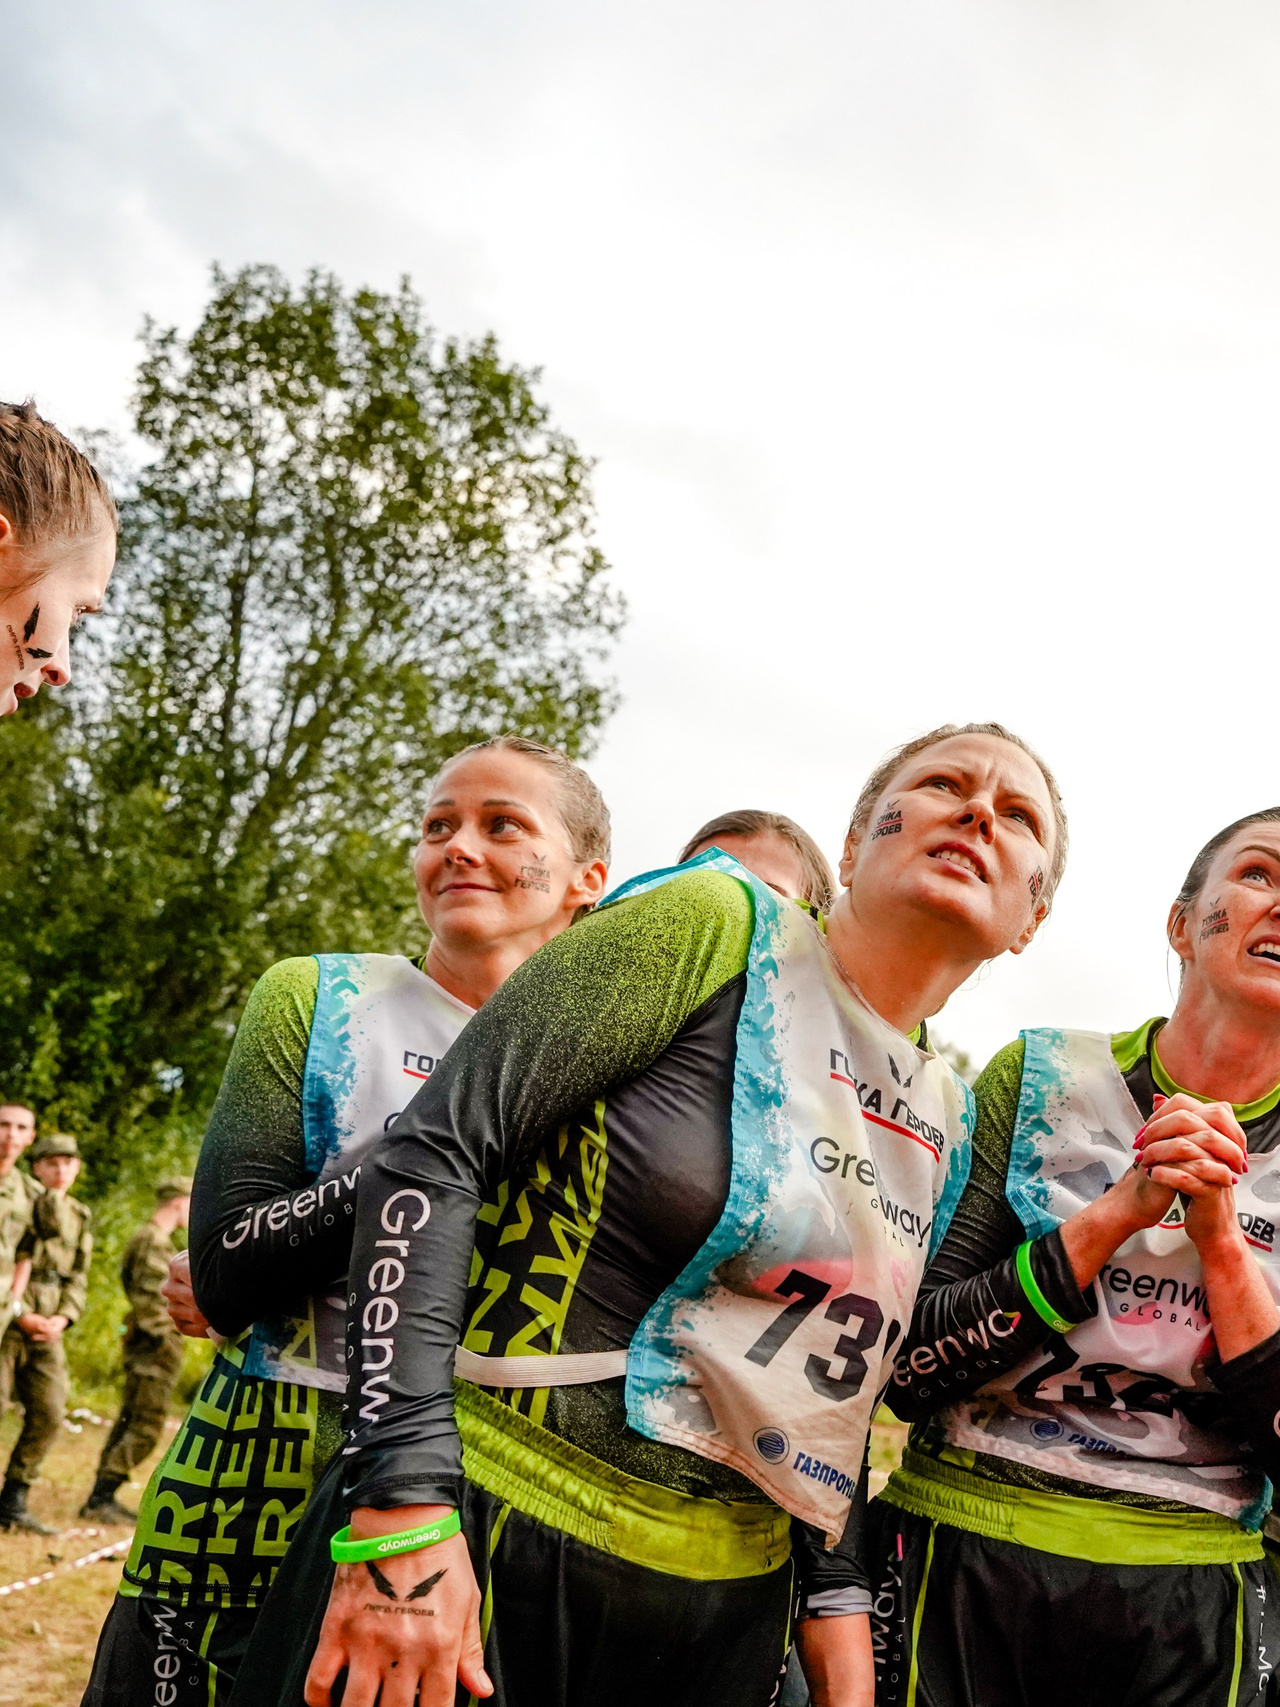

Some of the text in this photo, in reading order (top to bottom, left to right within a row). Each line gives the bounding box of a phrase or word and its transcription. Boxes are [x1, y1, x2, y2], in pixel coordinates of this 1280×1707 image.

[889, 1096, 946, 1154] ГЕРОЕВ
[1119, 1302, 1201, 1332] GLOBAL
[744, 1268, 904, 1403] 73
[385, 1528, 441, 1552] Greenway
[394, 1606, 435, 1617] ГЕРОЕВ
